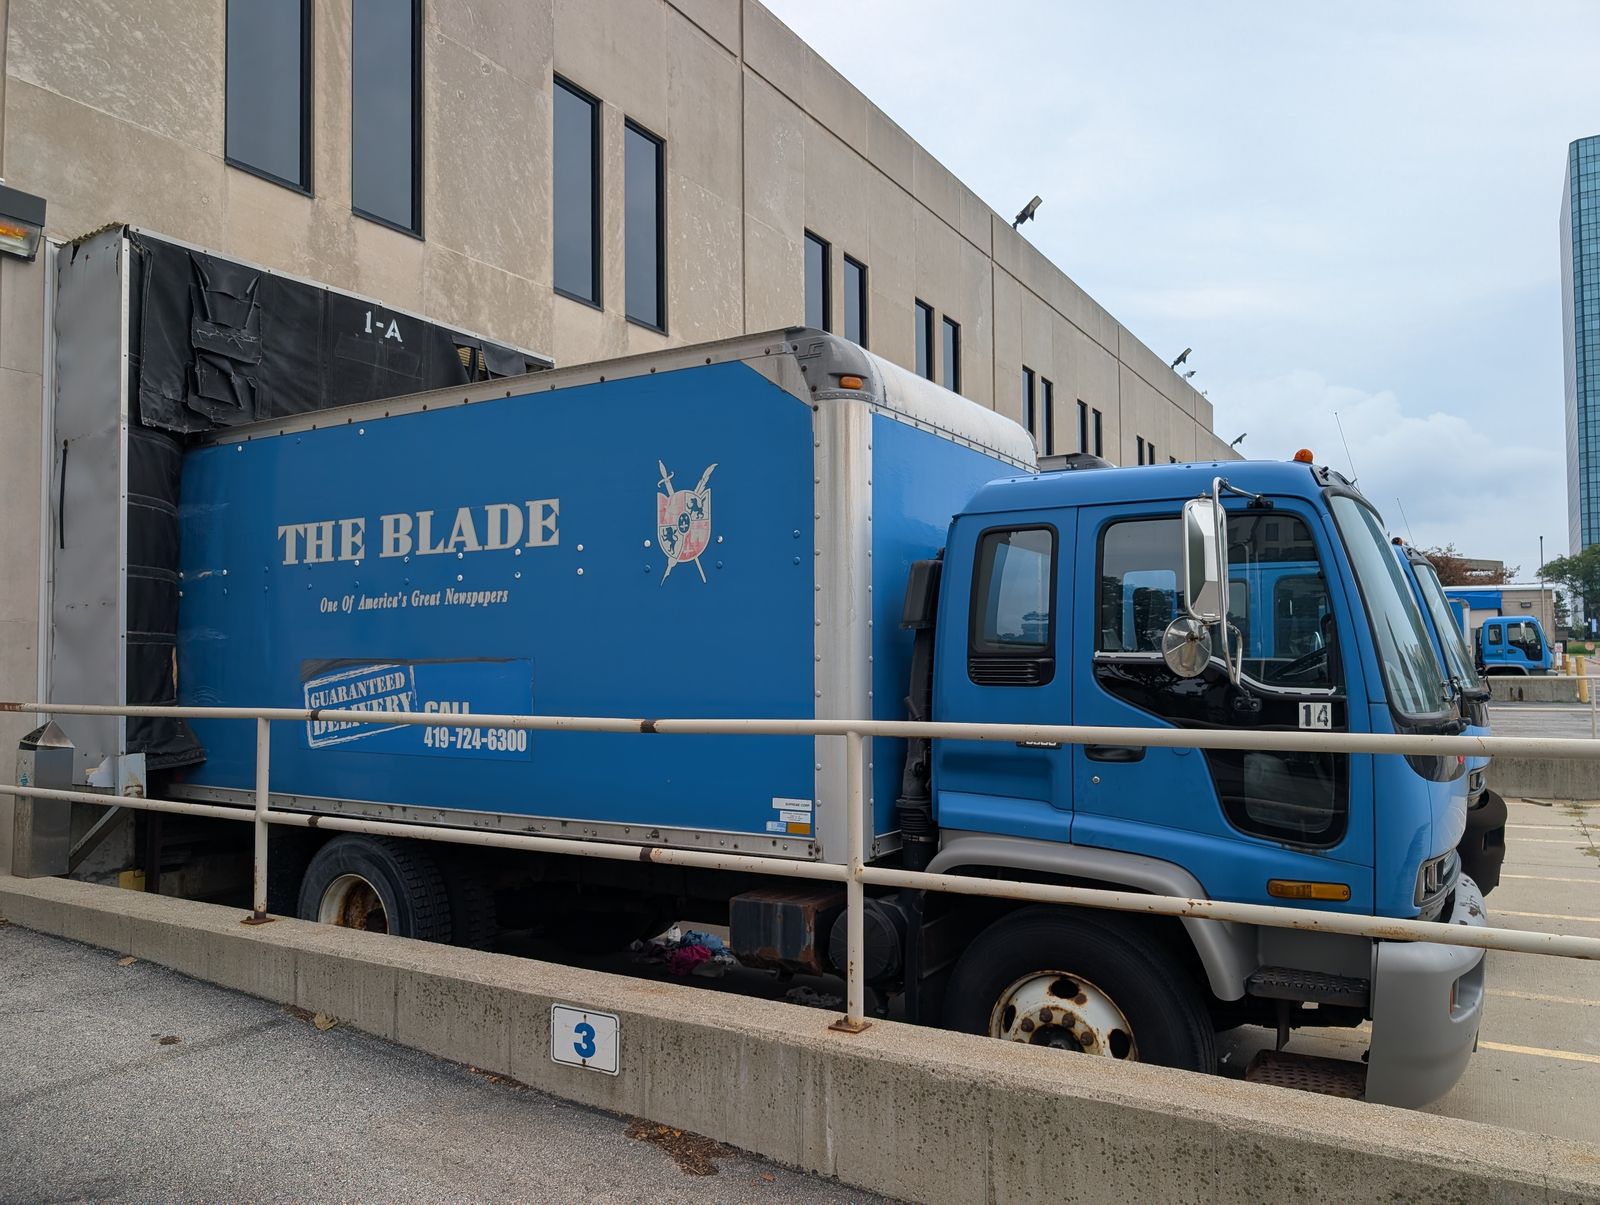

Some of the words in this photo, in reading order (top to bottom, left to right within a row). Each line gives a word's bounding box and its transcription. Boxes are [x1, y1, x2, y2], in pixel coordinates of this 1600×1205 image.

[365, 311, 403, 342] 1-A
[277, 517, 366, 565] THE
[379, 499, 560, 558] BLADE
[320, 597, 338, 613] One
[342, 595, 355, 614] Of
[358, 592, 407, 611] America's
[411, 590, 441, 607] Great
[445, 588, 509, 607] Newspapers
[310, 671, 406, 709] GUARANTEED
[1302, 704, 1329, 728] 14
[424, 726, 527, 752] 419-724-6300
[573, 1022, 596, 1058] 3
